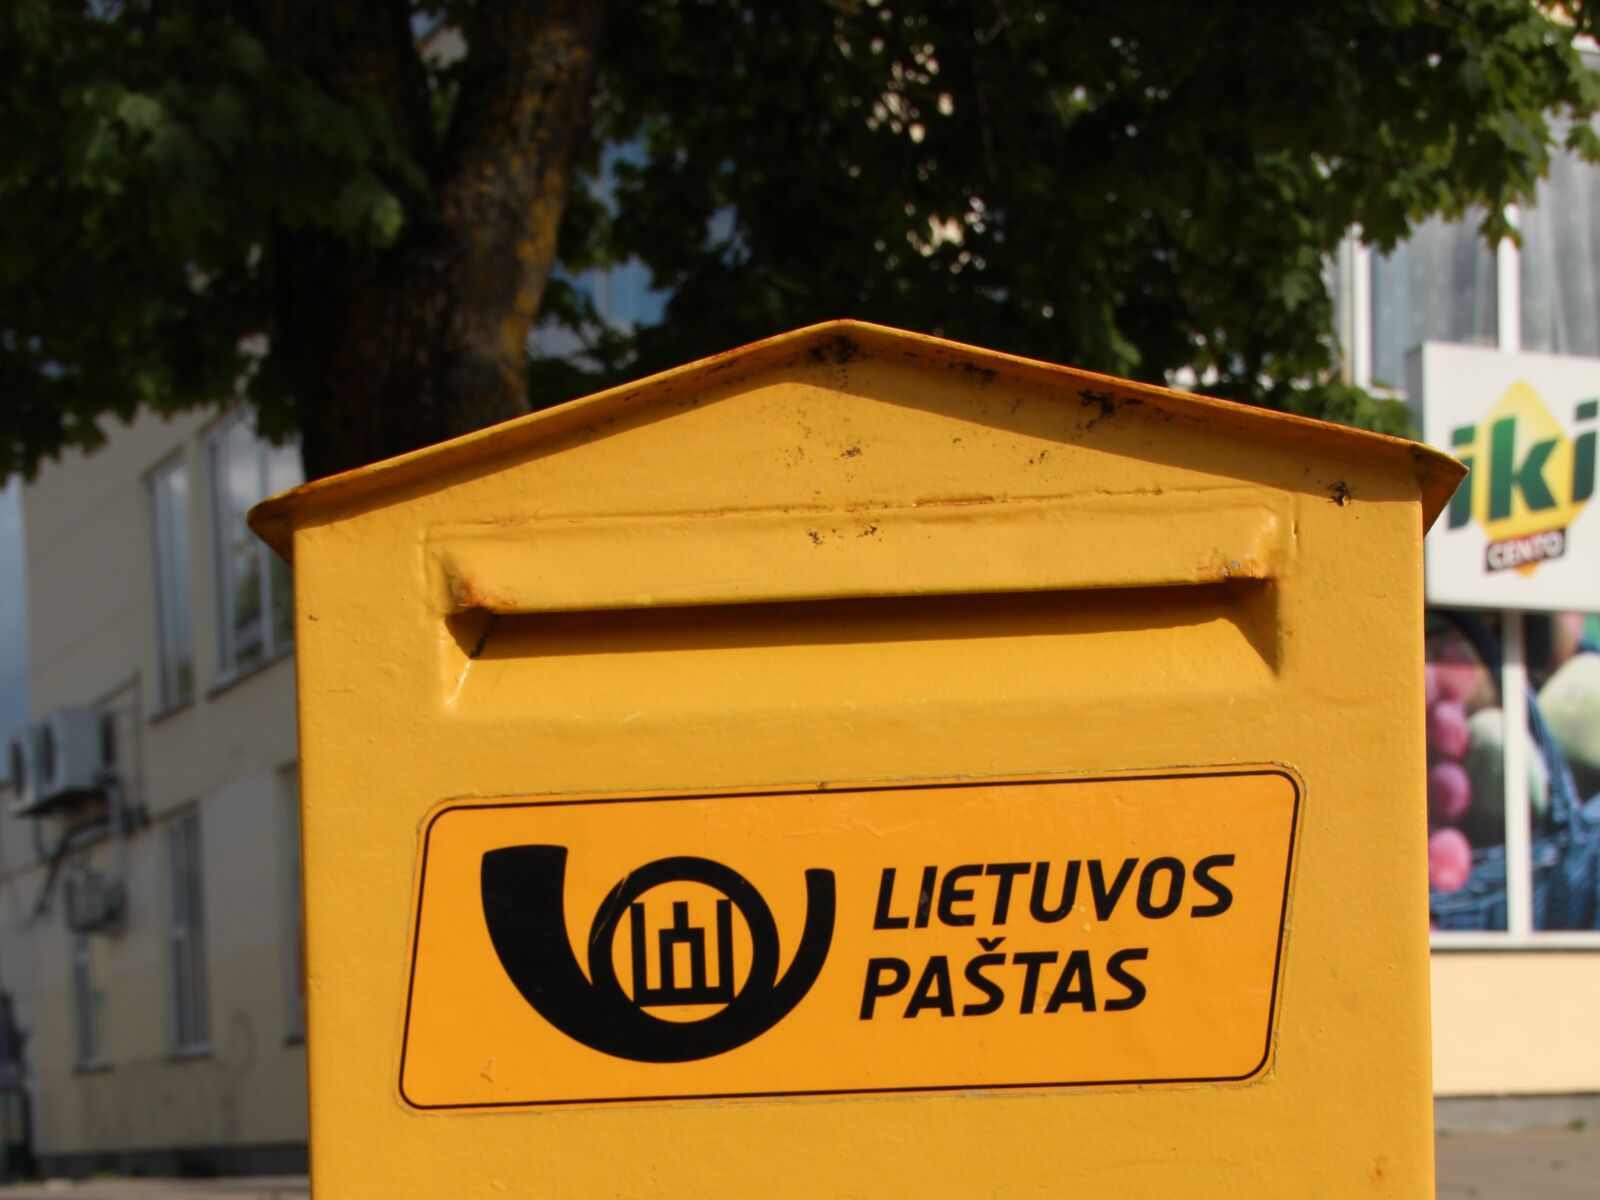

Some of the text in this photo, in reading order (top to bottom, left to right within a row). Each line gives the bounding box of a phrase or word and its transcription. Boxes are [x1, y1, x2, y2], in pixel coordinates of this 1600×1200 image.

[1449, 400, 1598, 531] iki
[1487, 531, 1563, 570] CENTO
[873, 854, 1235, 930] LIETUVOS
[859, 937, 1149, 1020] PAŠTAS
